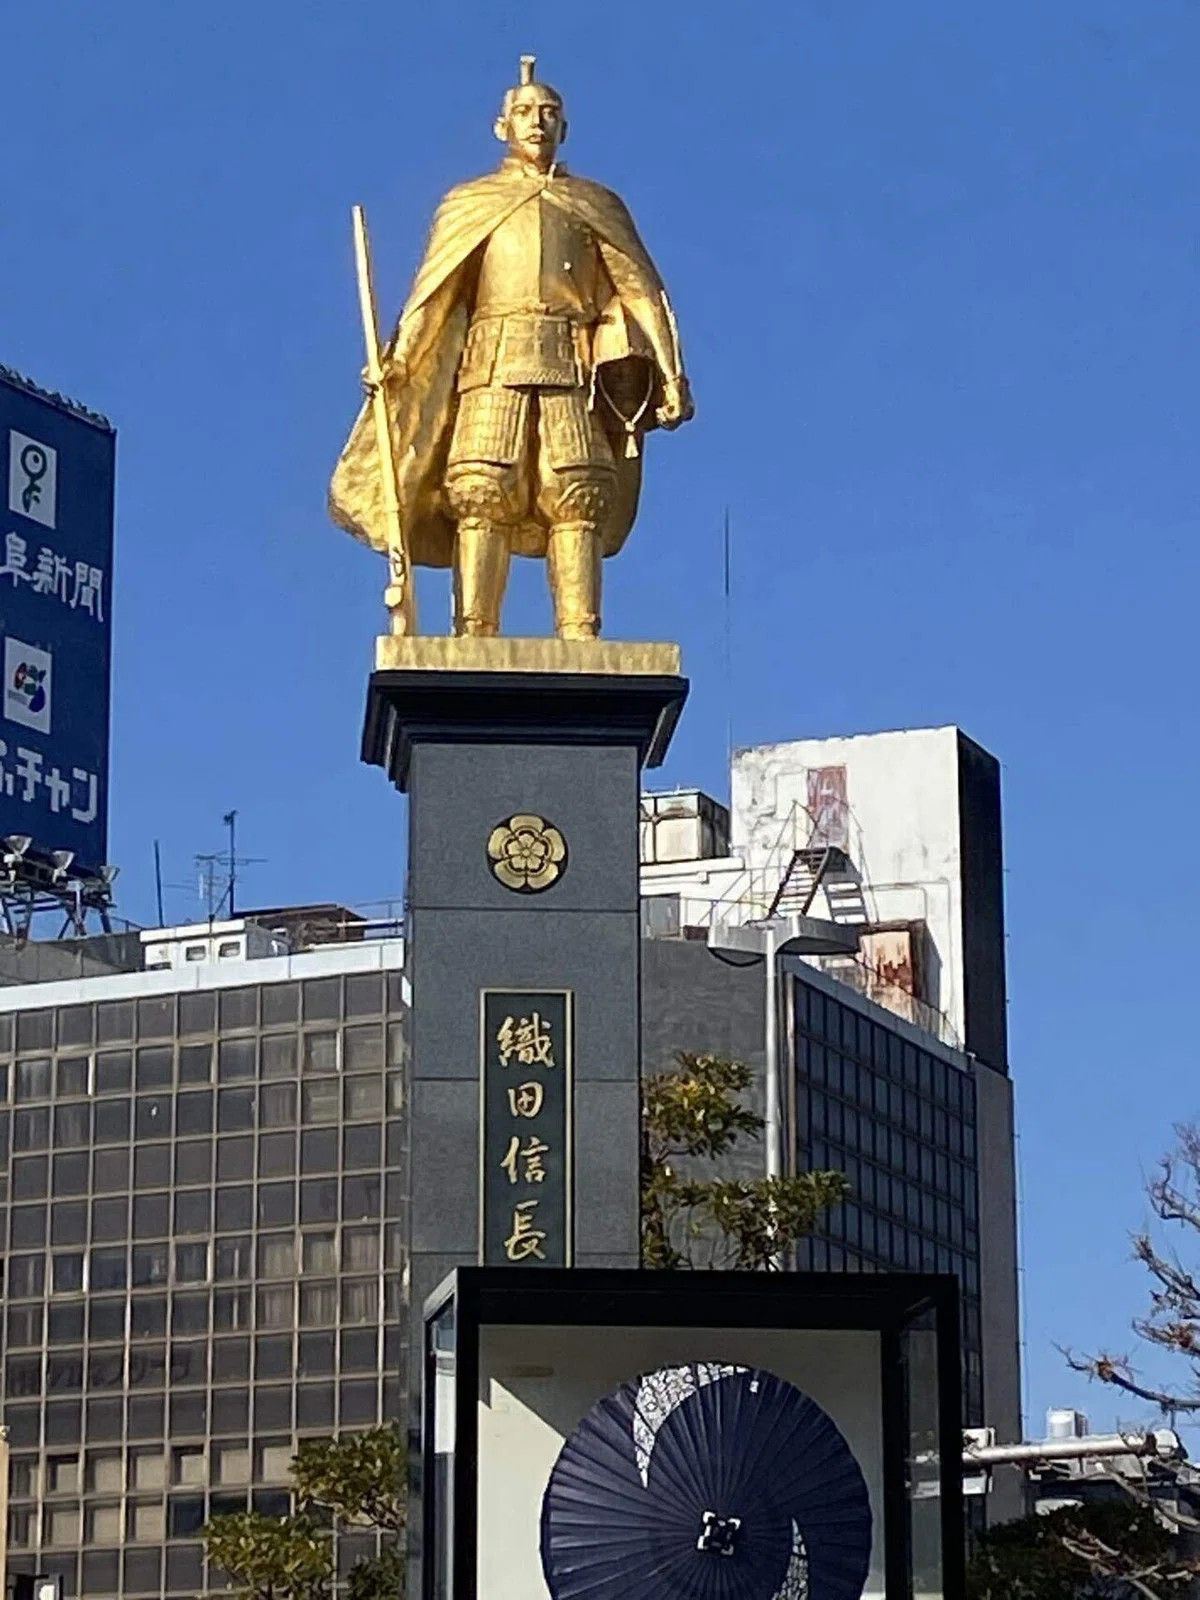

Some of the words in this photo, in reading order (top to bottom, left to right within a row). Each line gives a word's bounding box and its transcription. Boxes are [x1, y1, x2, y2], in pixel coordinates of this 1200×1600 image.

[0, 530, 104, 622] 阜新聞
[497, 1012, 555, 1261] 織田信長
